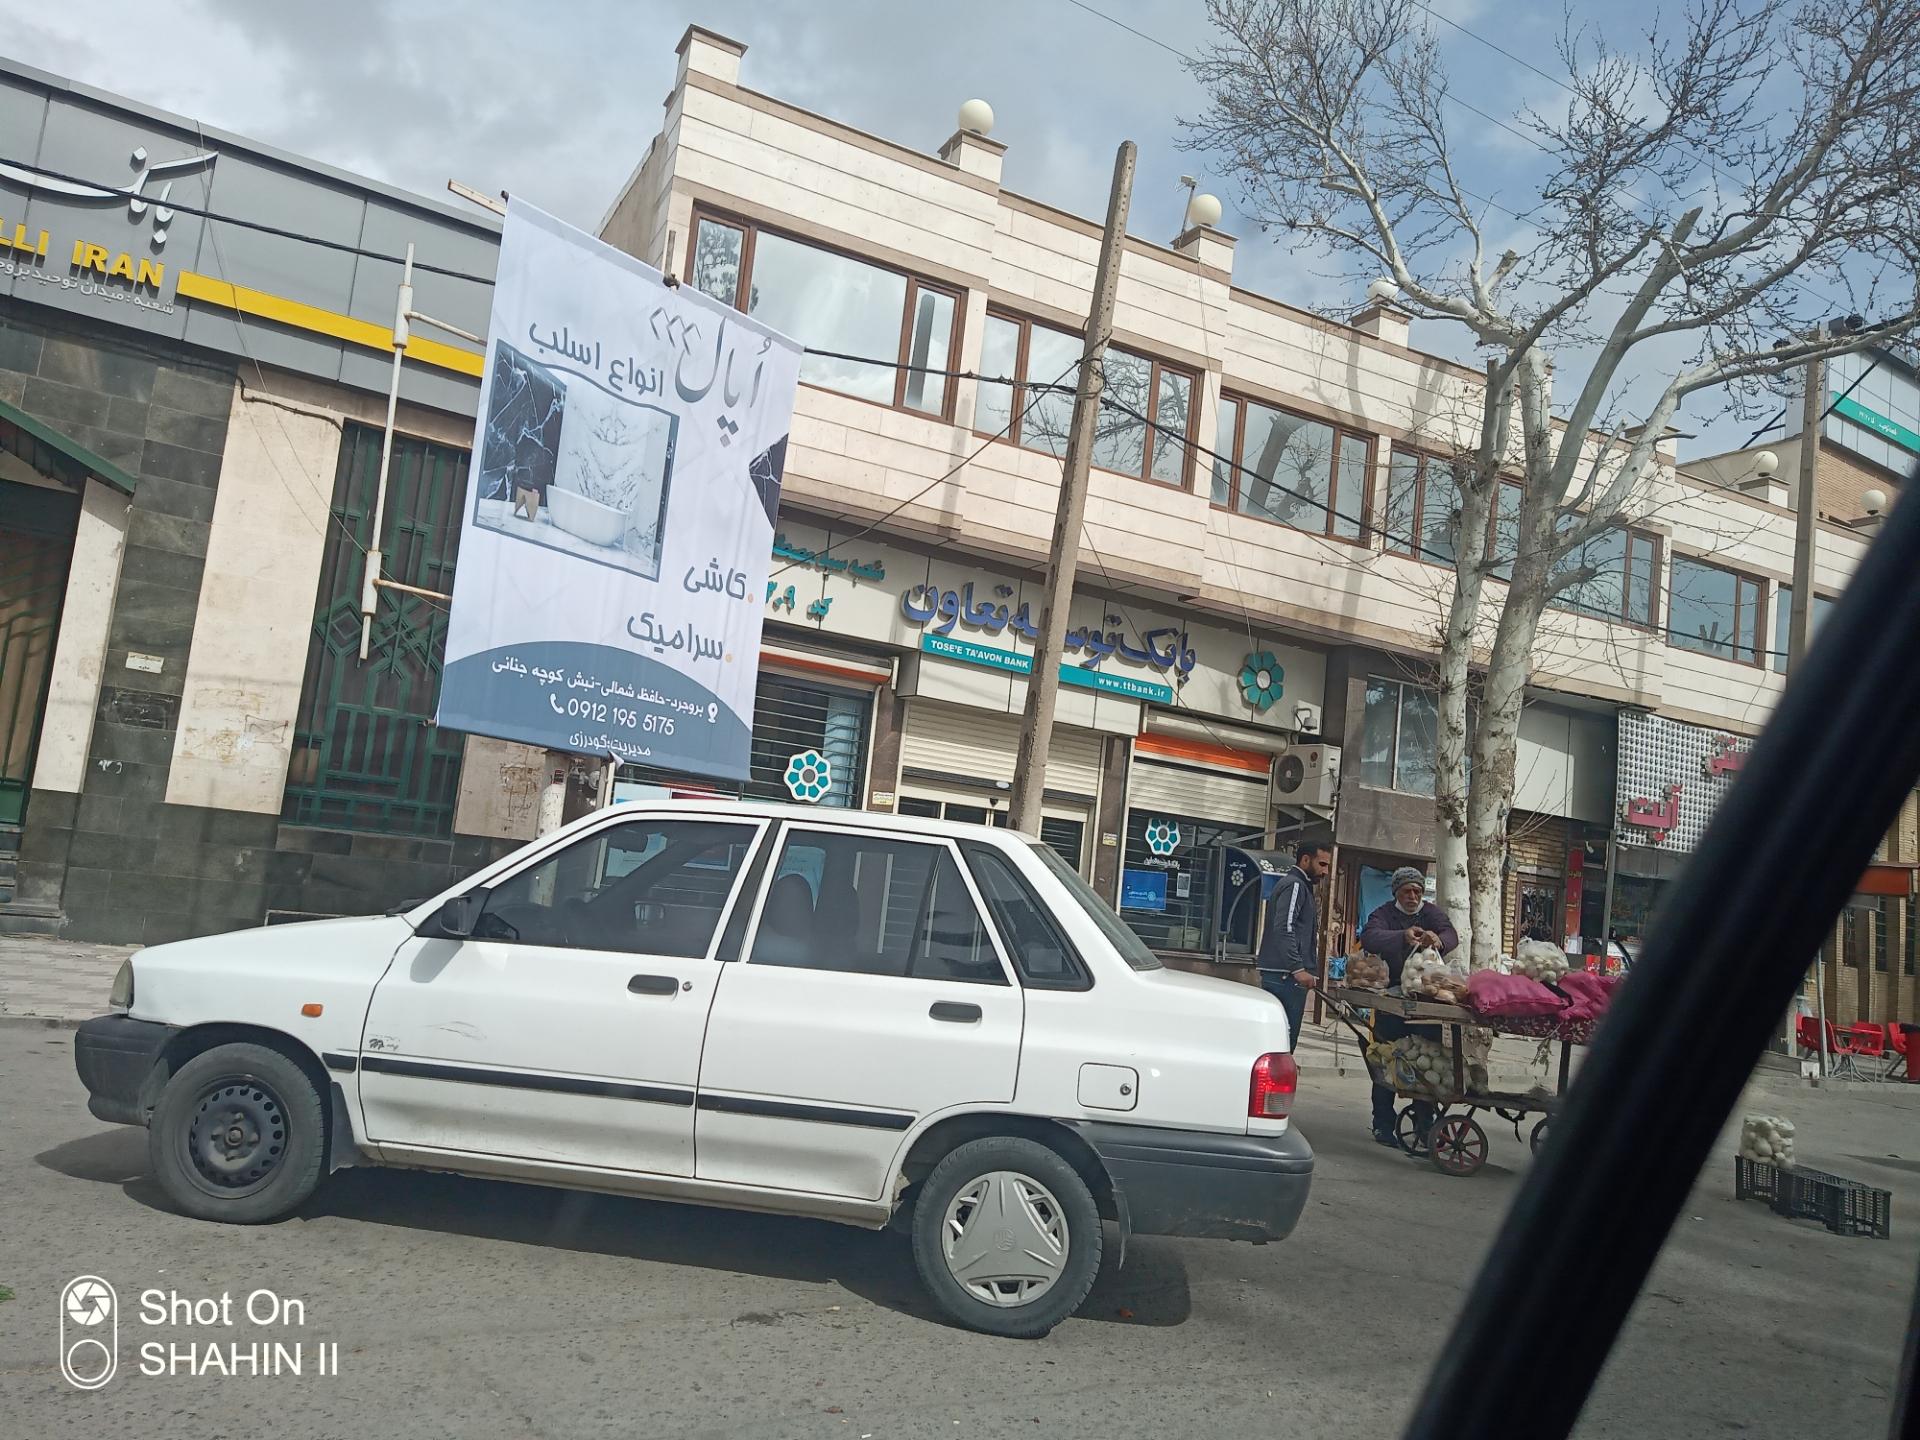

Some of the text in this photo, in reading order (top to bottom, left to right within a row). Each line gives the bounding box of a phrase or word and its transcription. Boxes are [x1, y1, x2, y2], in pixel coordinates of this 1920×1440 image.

[31, 269, 78, 290] توحید
[71, 240, 165, 287] IRAN
[80, 281, 125, 302] میدان
[134, 295, 175, 315] شعبه
[528, 322, 664, 398] انواع اسلب
[683, 557, 747, 601] کاشی
[626, 612, 724, 662] سرامیک
[902, 581, 1197, 687] بانک توسه تعاون
[930, 639, 1029, 669] TOSE'E TA'AVON BANK
[531, 666, 565, 686] کوچه
[1098, 677, 1165, 697] www.ttbank.ir
[567, 698, 676, 736] 0912 195 5175
